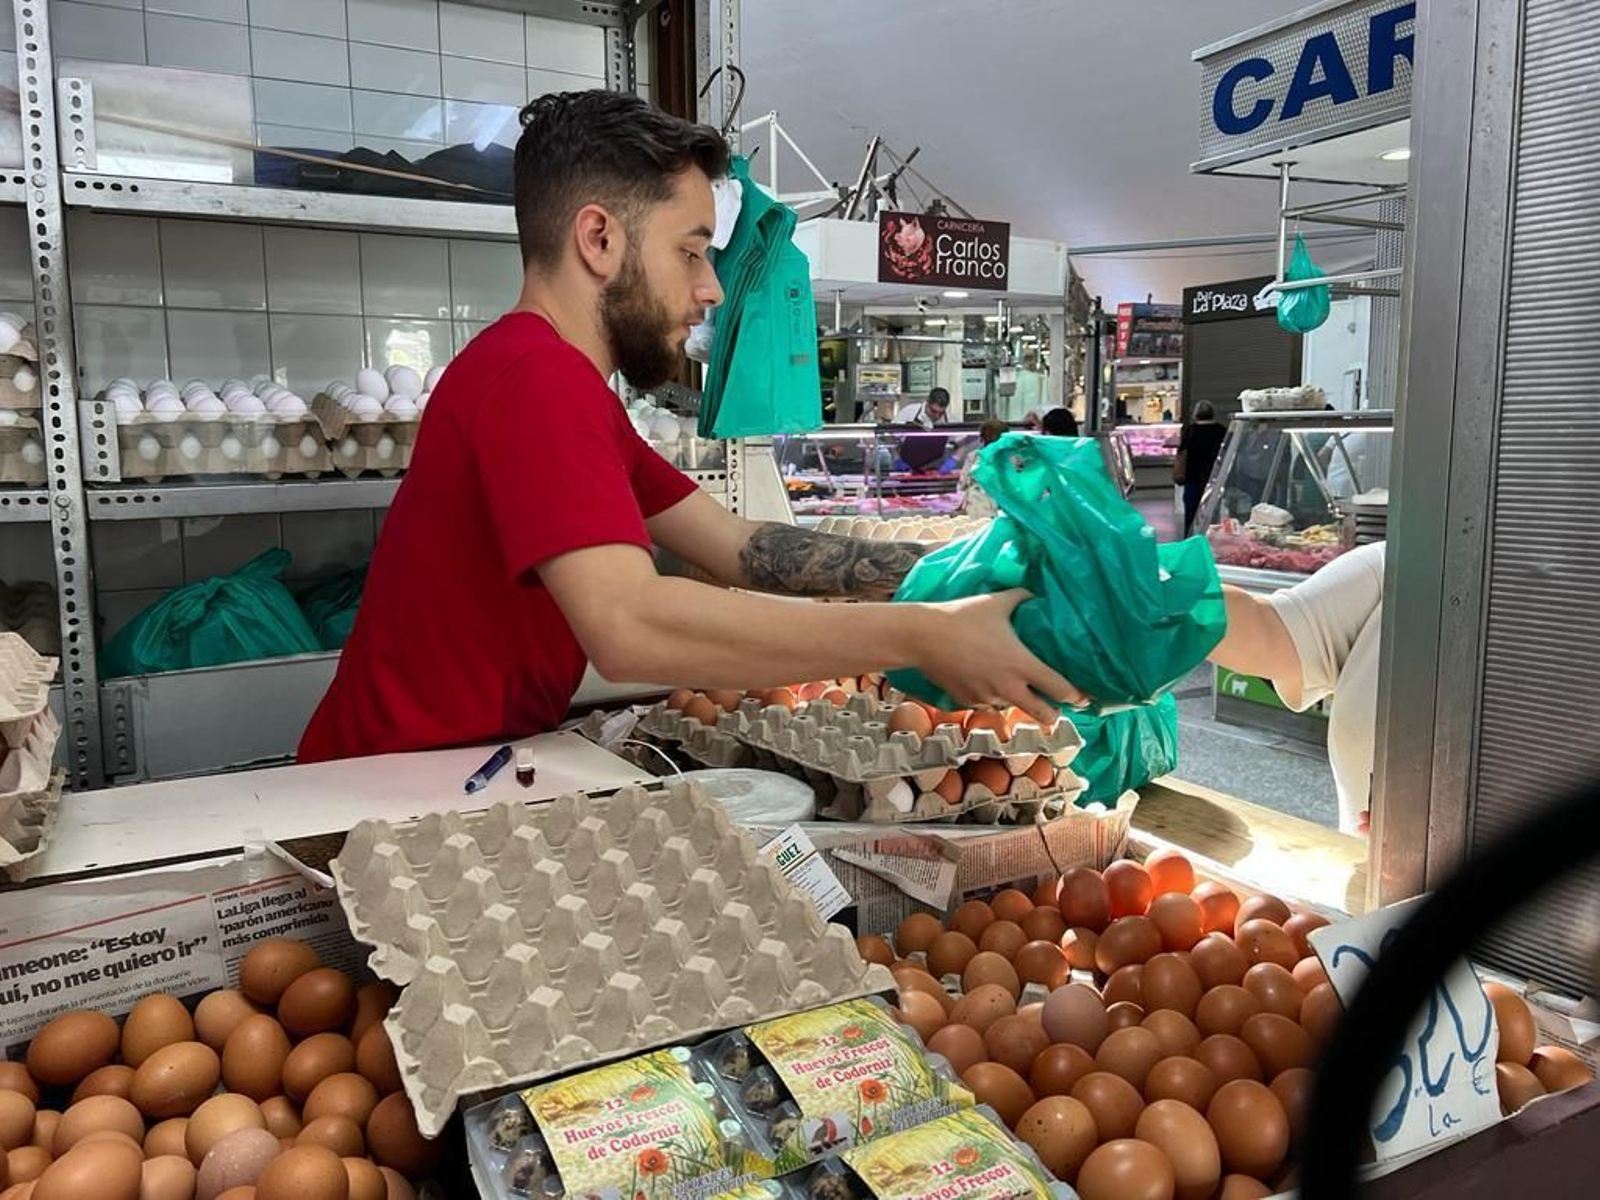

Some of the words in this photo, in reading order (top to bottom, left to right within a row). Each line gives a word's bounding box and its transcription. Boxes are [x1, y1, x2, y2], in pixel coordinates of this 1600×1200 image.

[936, 234, 1001, 260] Carlos
[936, 252, 1006, 279] Franco
[1192, 297, 1209, 314] La
[1212, 293, 1248, 312] Plaza
[216, 900, 261, 920] LaLiga
[261, 893, 294, 909] llega
[294, 887, 307, 900] al
[222, 929, 251, 948] más
[252, 911, 330, 938] comprimida
[0, 948, 89, 982] meone:
[30, 979, 62, 998] no
[64, 968, 101, 989] me
[103, 946, 176, 979] quiero
[79, 984, 132, 1007] presentación
[791, 1054, 841, 1076] Huevos
[840, 1037, 891, 1061] Frescos
[821, 1036, 840, 1048] 12
[815, 1076, 832, 1090] de
[832, 1057, 895, 1084] Codorniz
[604, 1098, 626, 1111] 12
[563, 1118, 624, 1145] Huevos
[625, 1100, 684, 1127] Frescos
[587, 1144, 607, 1161] de
[609, 1123, 682, 1153] Codorniz
[931, 1161, 954, 1176] 12
[955, 1164, 1012, 1192] Frescos
